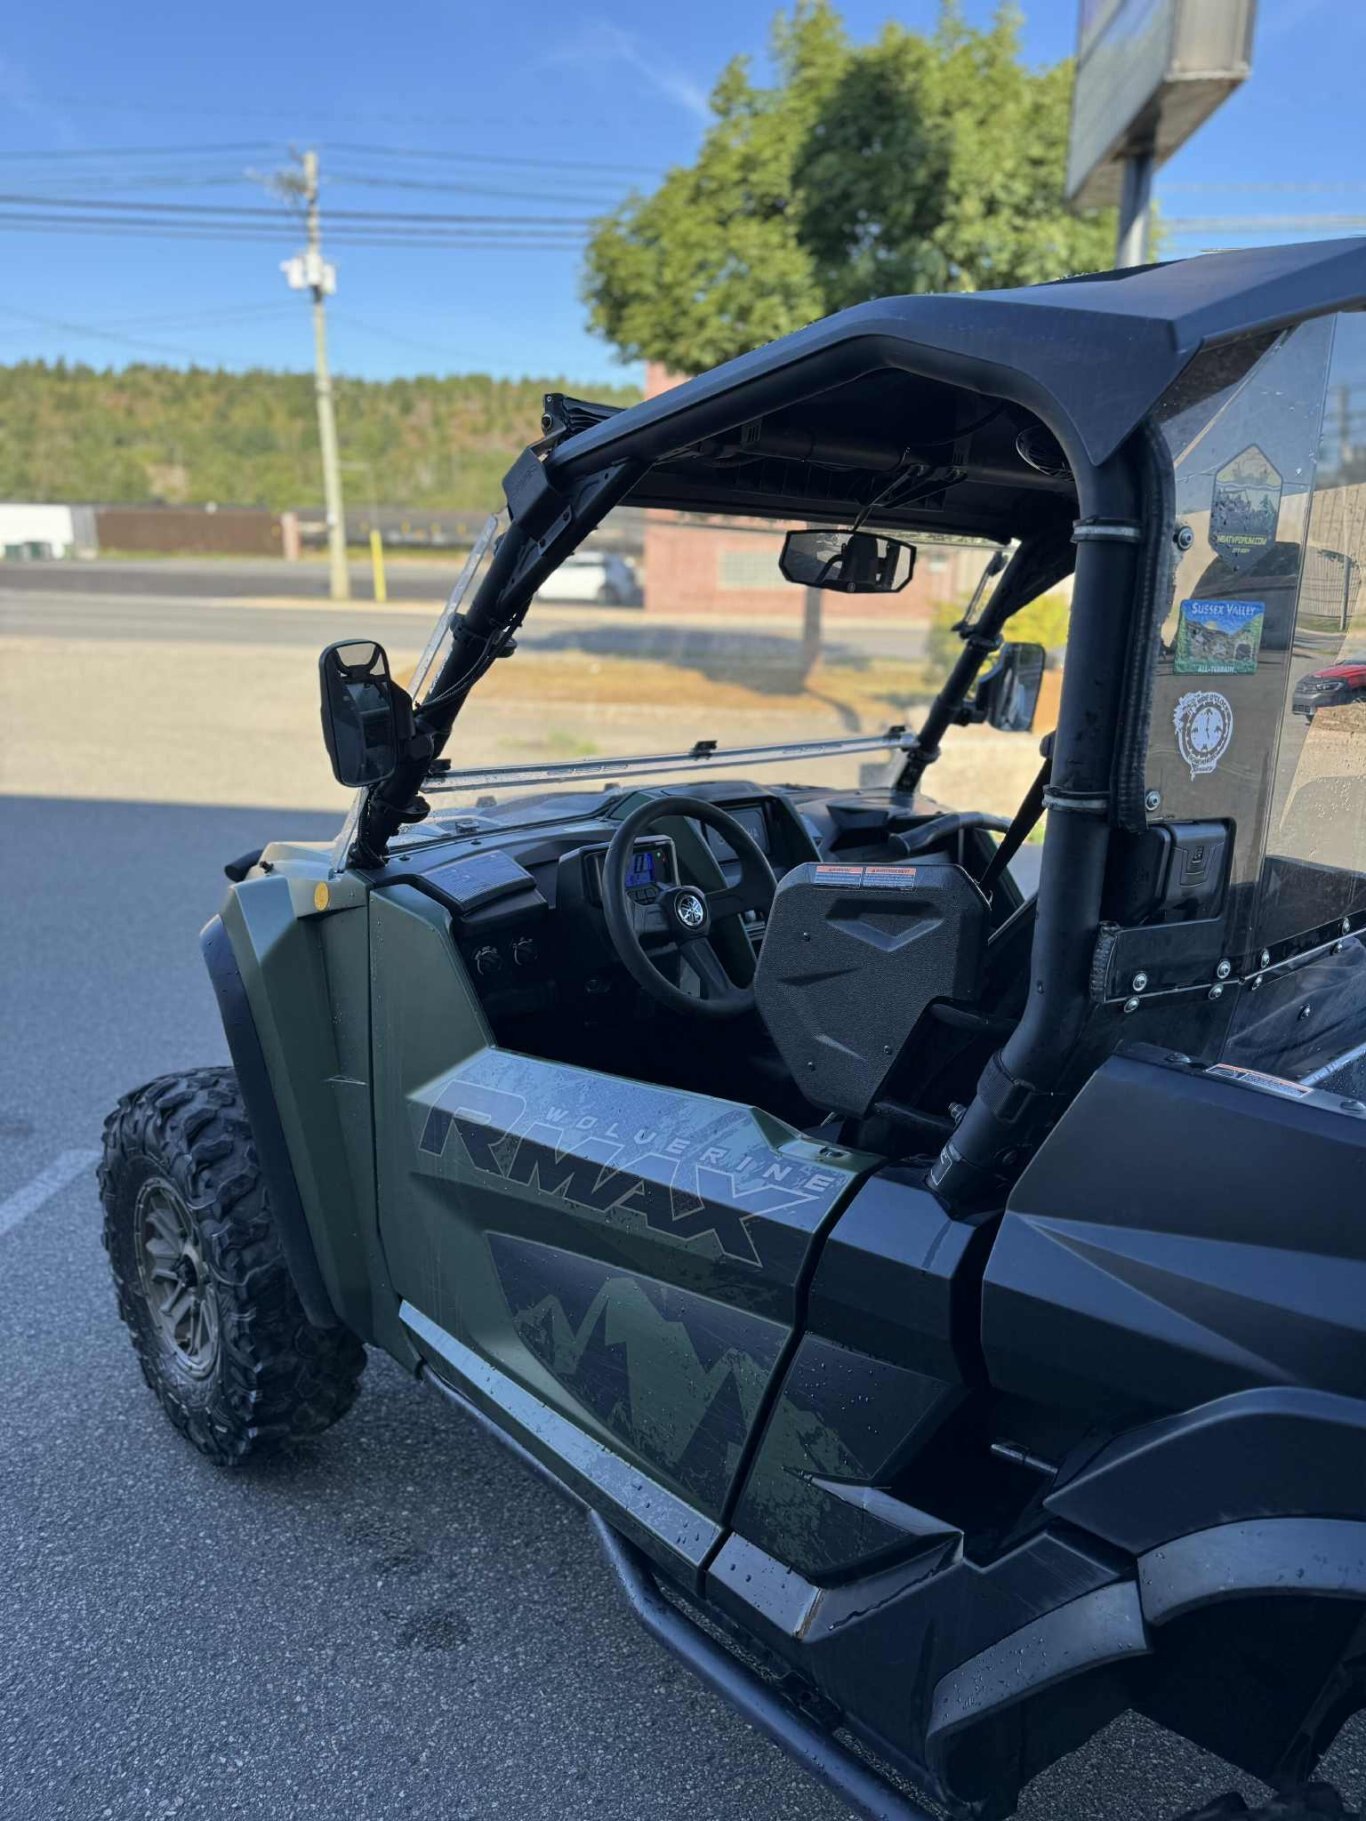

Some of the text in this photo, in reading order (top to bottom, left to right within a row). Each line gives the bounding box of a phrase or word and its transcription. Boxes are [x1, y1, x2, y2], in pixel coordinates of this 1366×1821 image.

[1192, 602, 1257, 616] SUSSEX VALLEY
[418, 1080, 820, 1268] RMAX
[545, 1105, 837, 1192] WOLVERINE
